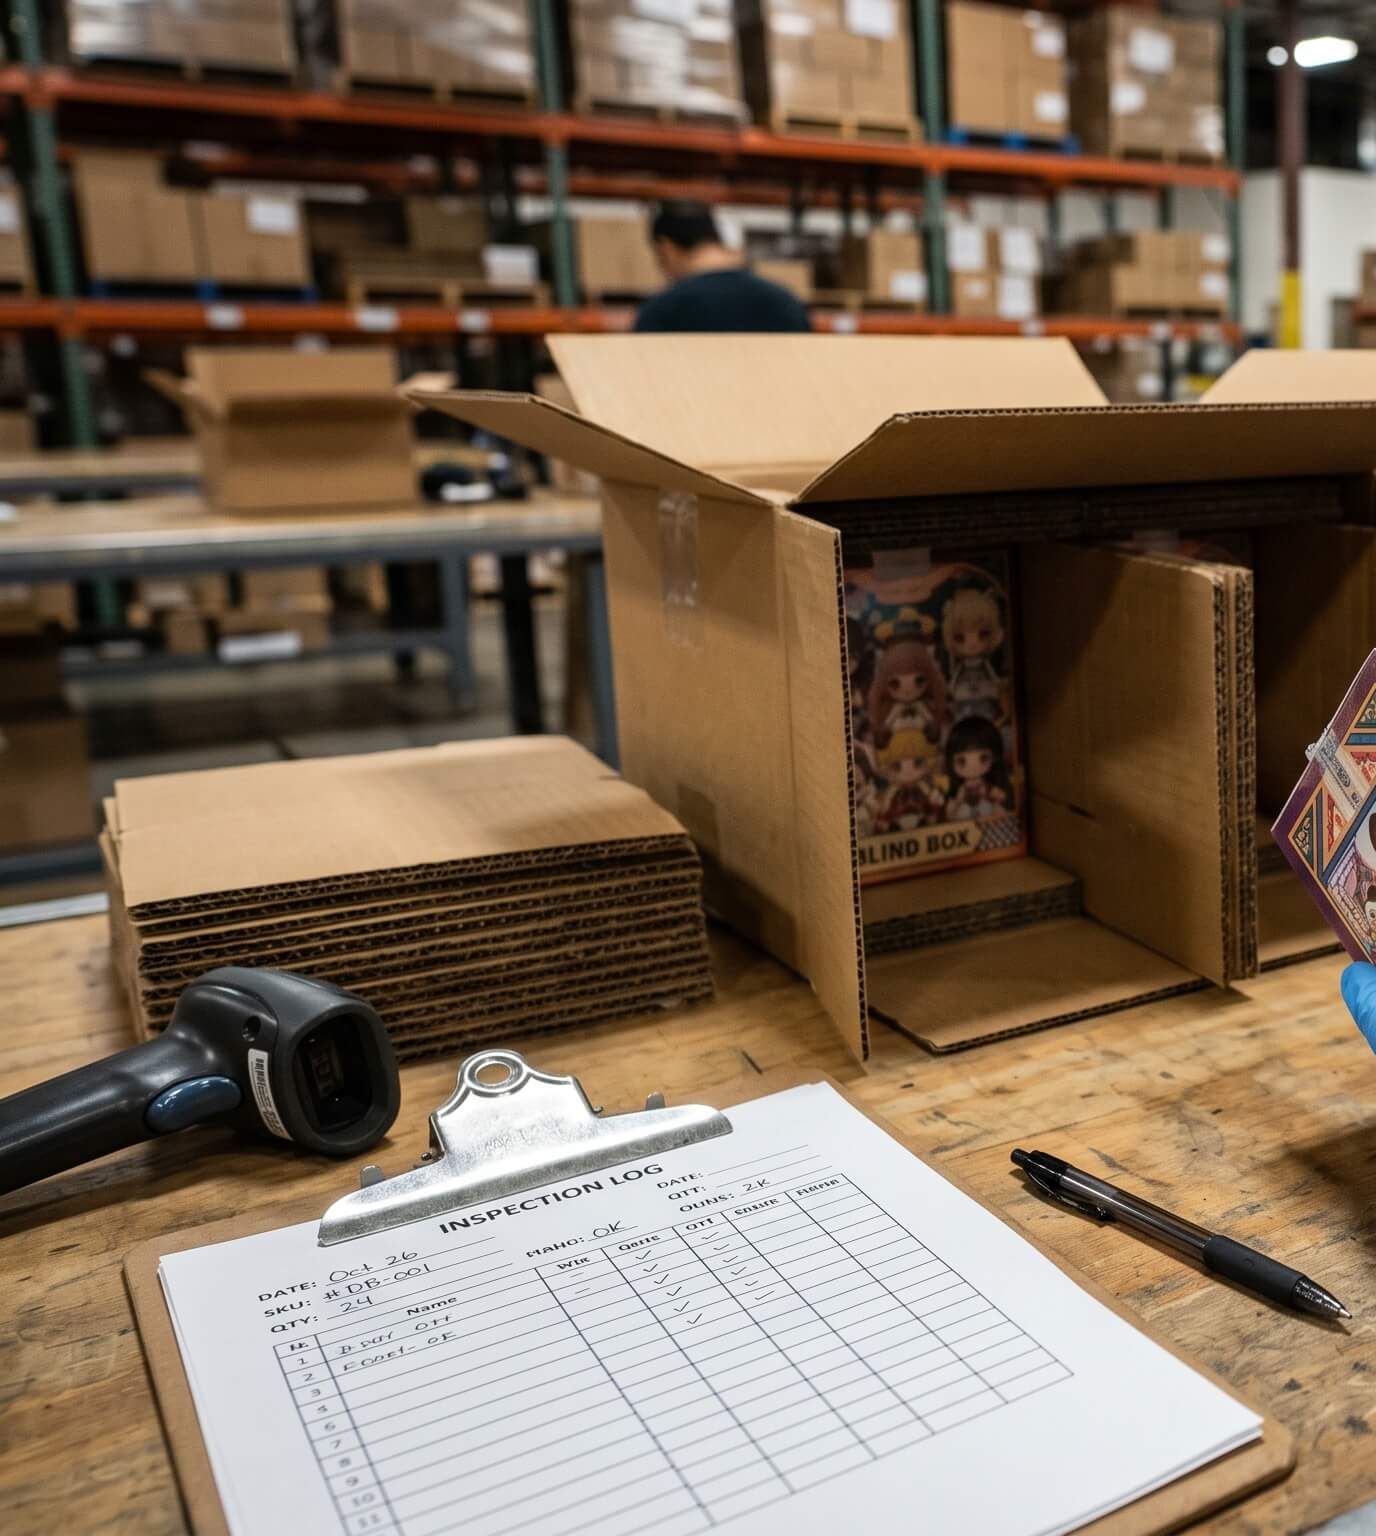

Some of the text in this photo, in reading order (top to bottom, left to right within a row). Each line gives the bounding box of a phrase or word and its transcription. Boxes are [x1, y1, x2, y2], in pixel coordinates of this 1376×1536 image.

[927, 829, 970, 854] BOX
[656, 1172, 704, 1190] DATE:
[439, 1164, 663, 1234] INSPECTION LOG
[592, 1220, 625, 1238] OK
[329, 1251, 418, 1283] Oct 26
[258, 1280, 317, 1302] DATE:
[263, 1300, 311, 1318] SKU:
[340, 1295, 373, 1313] 24
[406, 1297, 457, 1315] Name
[270, 1315, 319, 1333] QTY:
[303, 1373, 314, 1382] 2
[311, 1388, 321, 1397] 3
[324, 1422, 336, 1431] 6
[330, 1439, 341, 1448] 7
[345, 1476, 359, 1486] 9
[352, 1492, 375, 1507] 10
